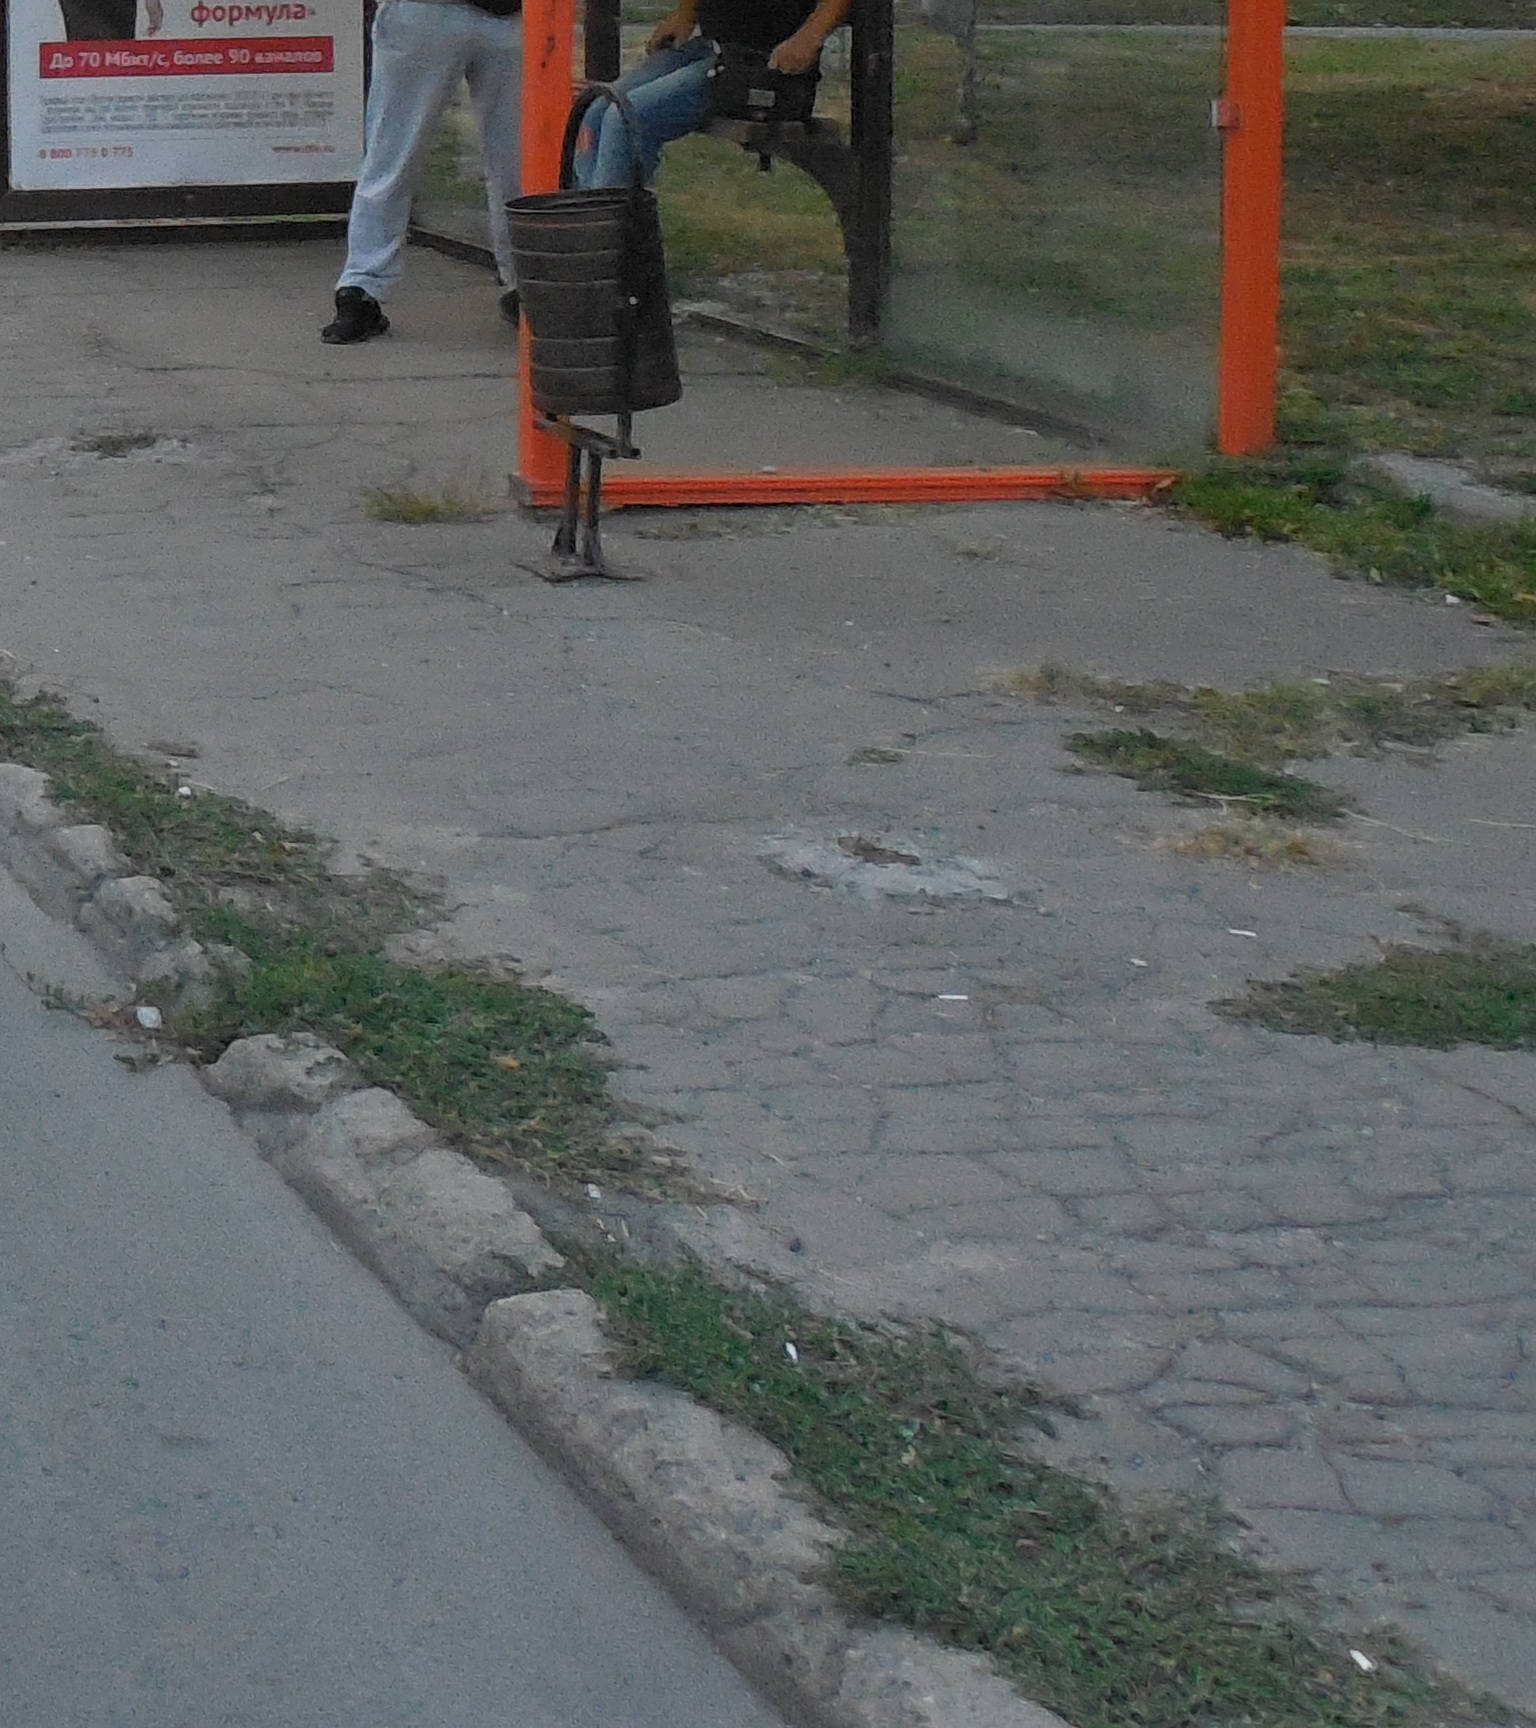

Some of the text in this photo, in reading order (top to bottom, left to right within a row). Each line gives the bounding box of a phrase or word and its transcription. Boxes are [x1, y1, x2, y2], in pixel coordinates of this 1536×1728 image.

[49, 52, 74, 69] До
[79, 51, 100, 68] 70
[173, 48, 223, 65] более
[229, 47, 249, 63] 90
